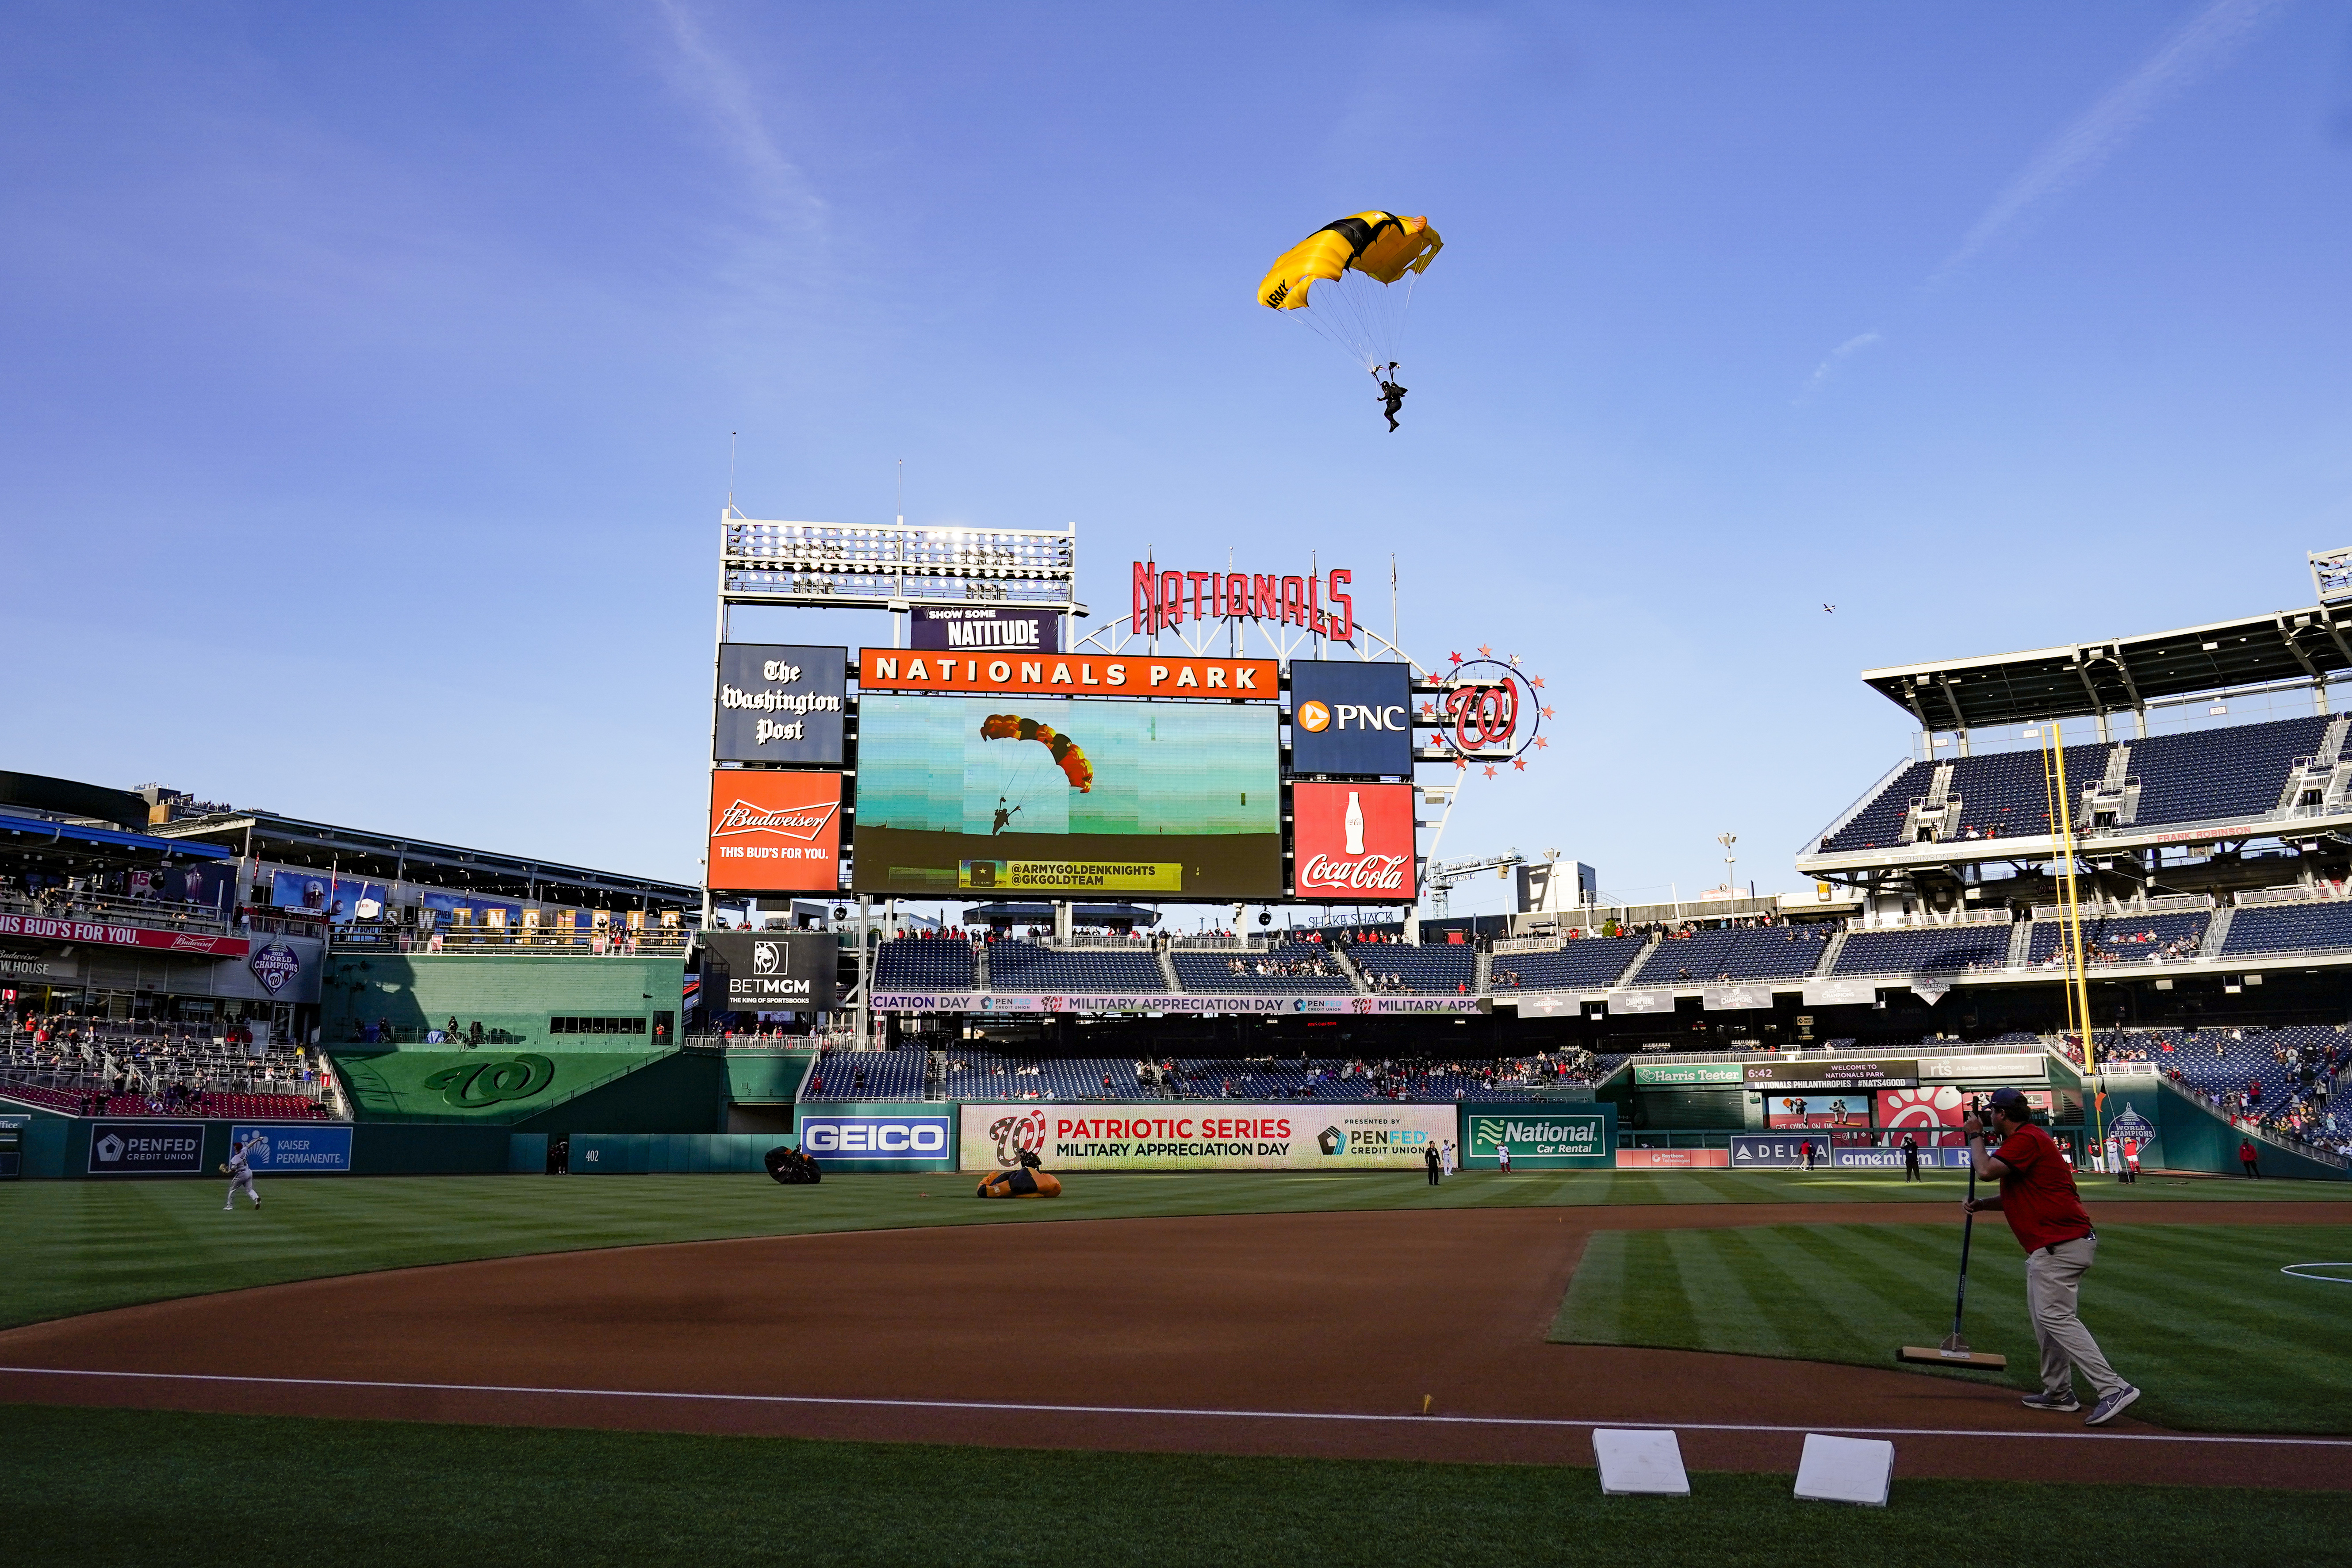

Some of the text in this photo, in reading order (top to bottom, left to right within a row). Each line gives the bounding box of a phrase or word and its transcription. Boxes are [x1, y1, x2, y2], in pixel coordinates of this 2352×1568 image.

[1266, 279, 1288, 309] ARMY
[1133, 561, 1352, 641] NATIONALS
[929, 609, 996, 619] SHOW SOME
[948, 619, 1039, 646] NATITUDE
[763, 659, 801, 684] The
[877, 658, 1257, 690] NATIONALS PARK
[721, 684, 841, 716] Washington
[1333, 704, 1406, 731] PNC
[756, 718, 804, 745] Post
[724, 808, 826, 827] Budweiser
[2157, 827, 2252, 843] FRANK ROBINSON
[720, 847, 829, 859] THIS BUD'S FOR YOU.
[1011, 864, 1155, 875] @ARMYGOLDENKNIGHTS
[1302, 854, 1409, 890] Coca-Cola
[1011, 874, 1103, 886] @GKGOLDTEAM
[1309, 912, 1394, 928] SHAKE SHACK
[0, 916, 140, 944] HIS BUD'S FOR YOU.
[176, 937, 213, 947] Budweiser
[0, 950, 39, 961] Budweiser
[262, 953, 292, 963] WORLD
[13, 962, 49, 974] HOUSE
[254, 960, 298, 973] CHAMPIONS
[730, 979, 810, 993] BETMGM
[870, 997, 971, 1008] CIATION DAY
[1069, 998, 1283, 1011] MILITARY APPRECIATION DAY
[1379, 1001, 1479, 1012] MILITARY APP
[1625, 997, 1655, 1006] CHAMPIONS
[1655, 1070, 1739, 1081] Harris Teeter
[1748, 1068, 1773, 1078] 6:42
[1930, 1062, 1952, 1076] rts
[1793, 1080, 1852, 1089] PHILANTHROPIES
[1858, 1079, 1906, 1087] #NATS4GOOD
[1057, 1119, 1291, 1139] PATRIOTIC SERIES
[1505, 1122, 1595, 1142] National
[806, 1125, 944, 1151] GEICO
[1351, 1131, 1427, 1144] PENFED
[128, 1139, 196, 1151] PENFED
[278, 1140, 310, 1150] KAISER
[1057, 1143, 1290, 1156] MILITARY APPRECIATION DAY
[1537, 1144, 1592, 1153] Car Rental
[1758, 1145, 1827, 1158] DELA
[276, 1154, 341, 1163] PERMANENTE
[586, 1150, 599, 1162] 402
[1842, 1154, 1932, 1165] amentm
